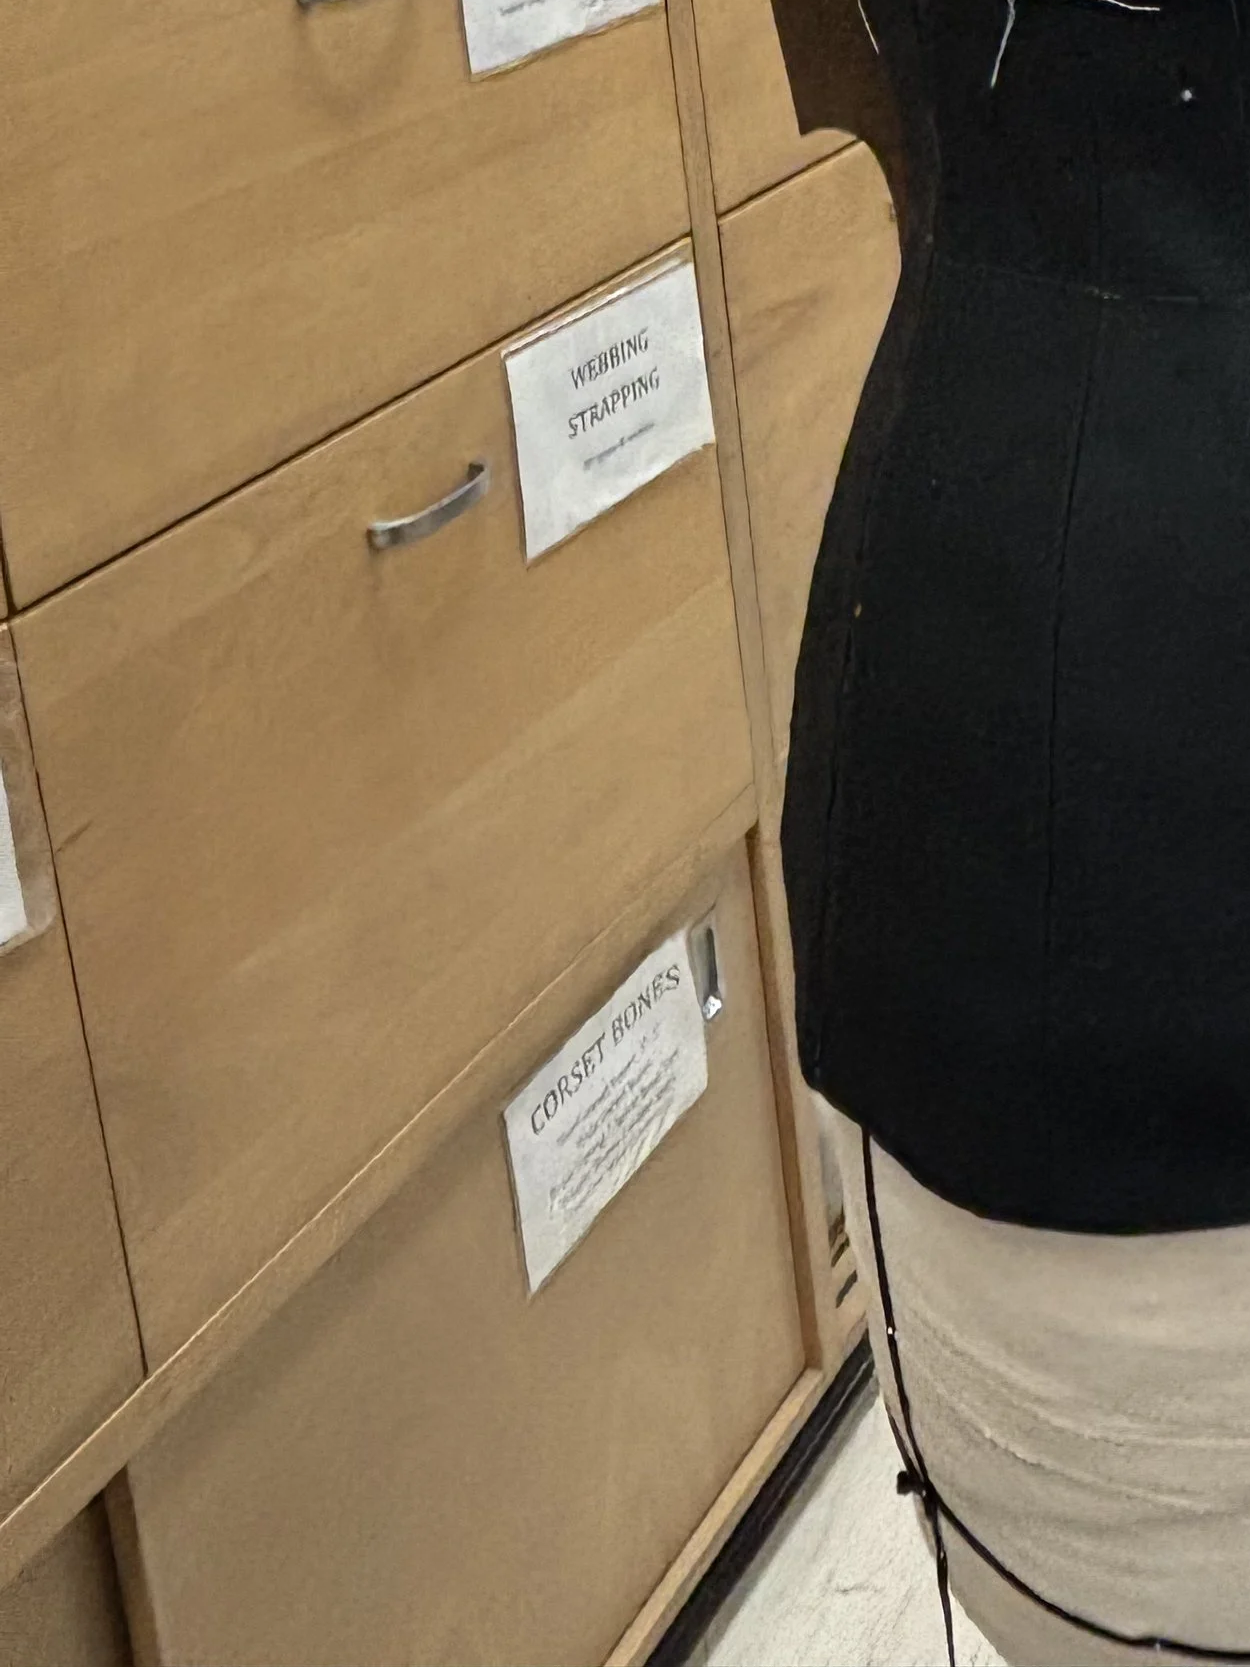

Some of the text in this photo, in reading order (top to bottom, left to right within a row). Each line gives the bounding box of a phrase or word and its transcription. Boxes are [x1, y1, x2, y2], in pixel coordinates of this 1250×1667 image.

[570, 325, 649, 390] WEBBING
[567, 366, 661, 440] STRAPPING
[530, 1031, 606, 1136] CORSET
[610, 964, 681, 1048] BONES
